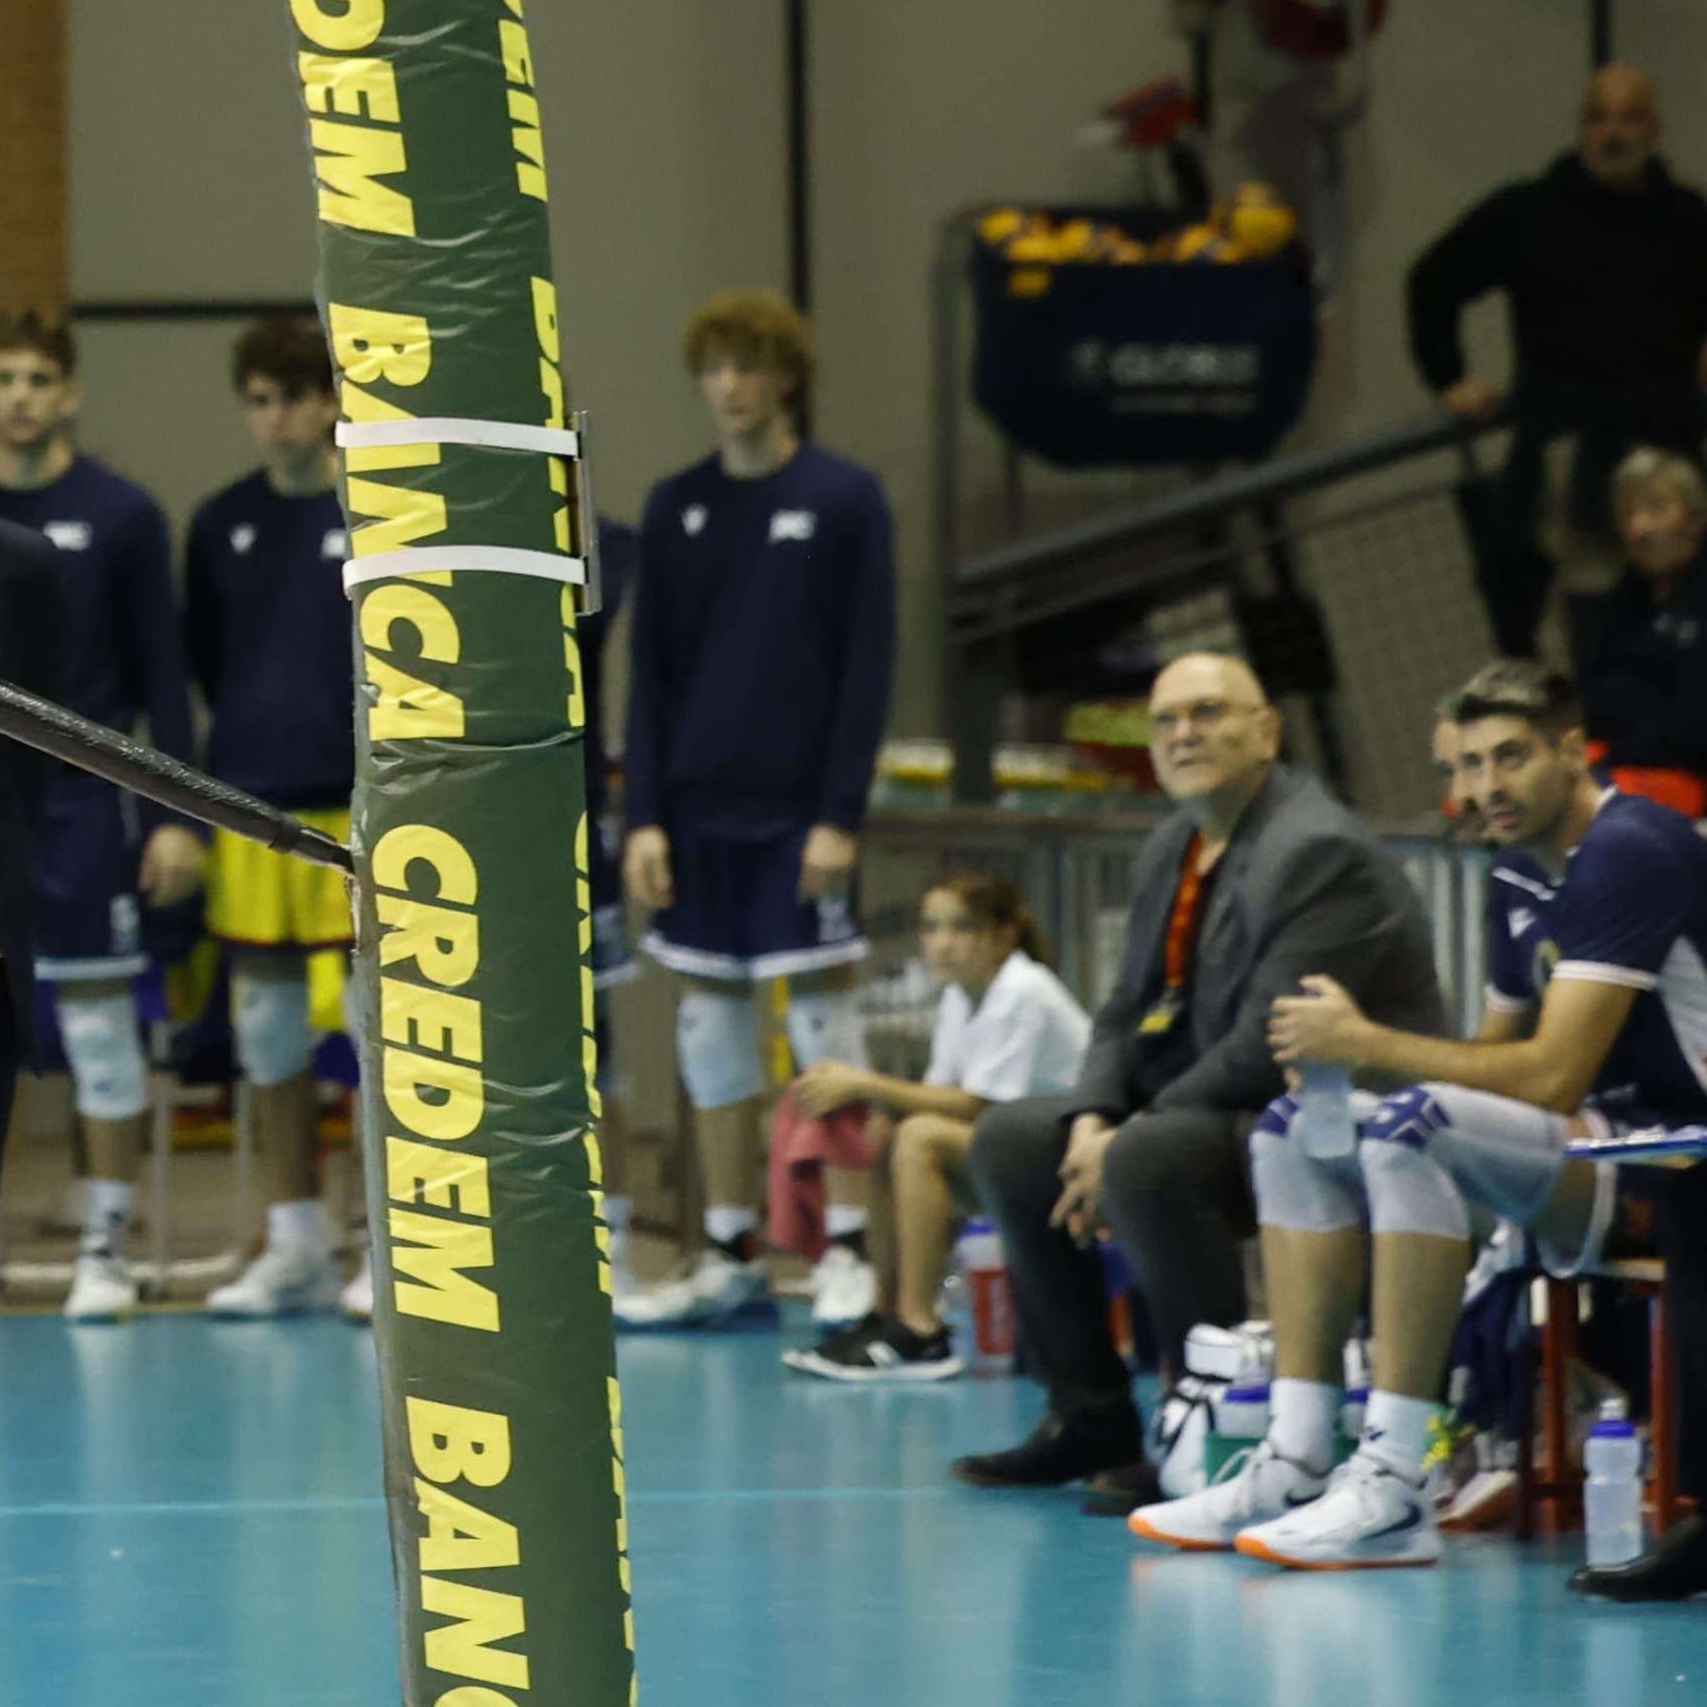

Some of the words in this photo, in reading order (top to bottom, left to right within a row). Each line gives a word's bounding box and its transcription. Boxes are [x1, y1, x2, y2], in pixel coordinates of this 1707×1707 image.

[327, 300, 465, 741] BANCA
[372, 823, 501, 1332] CREDEM
[405, 1395, 531, 1707] BAN
